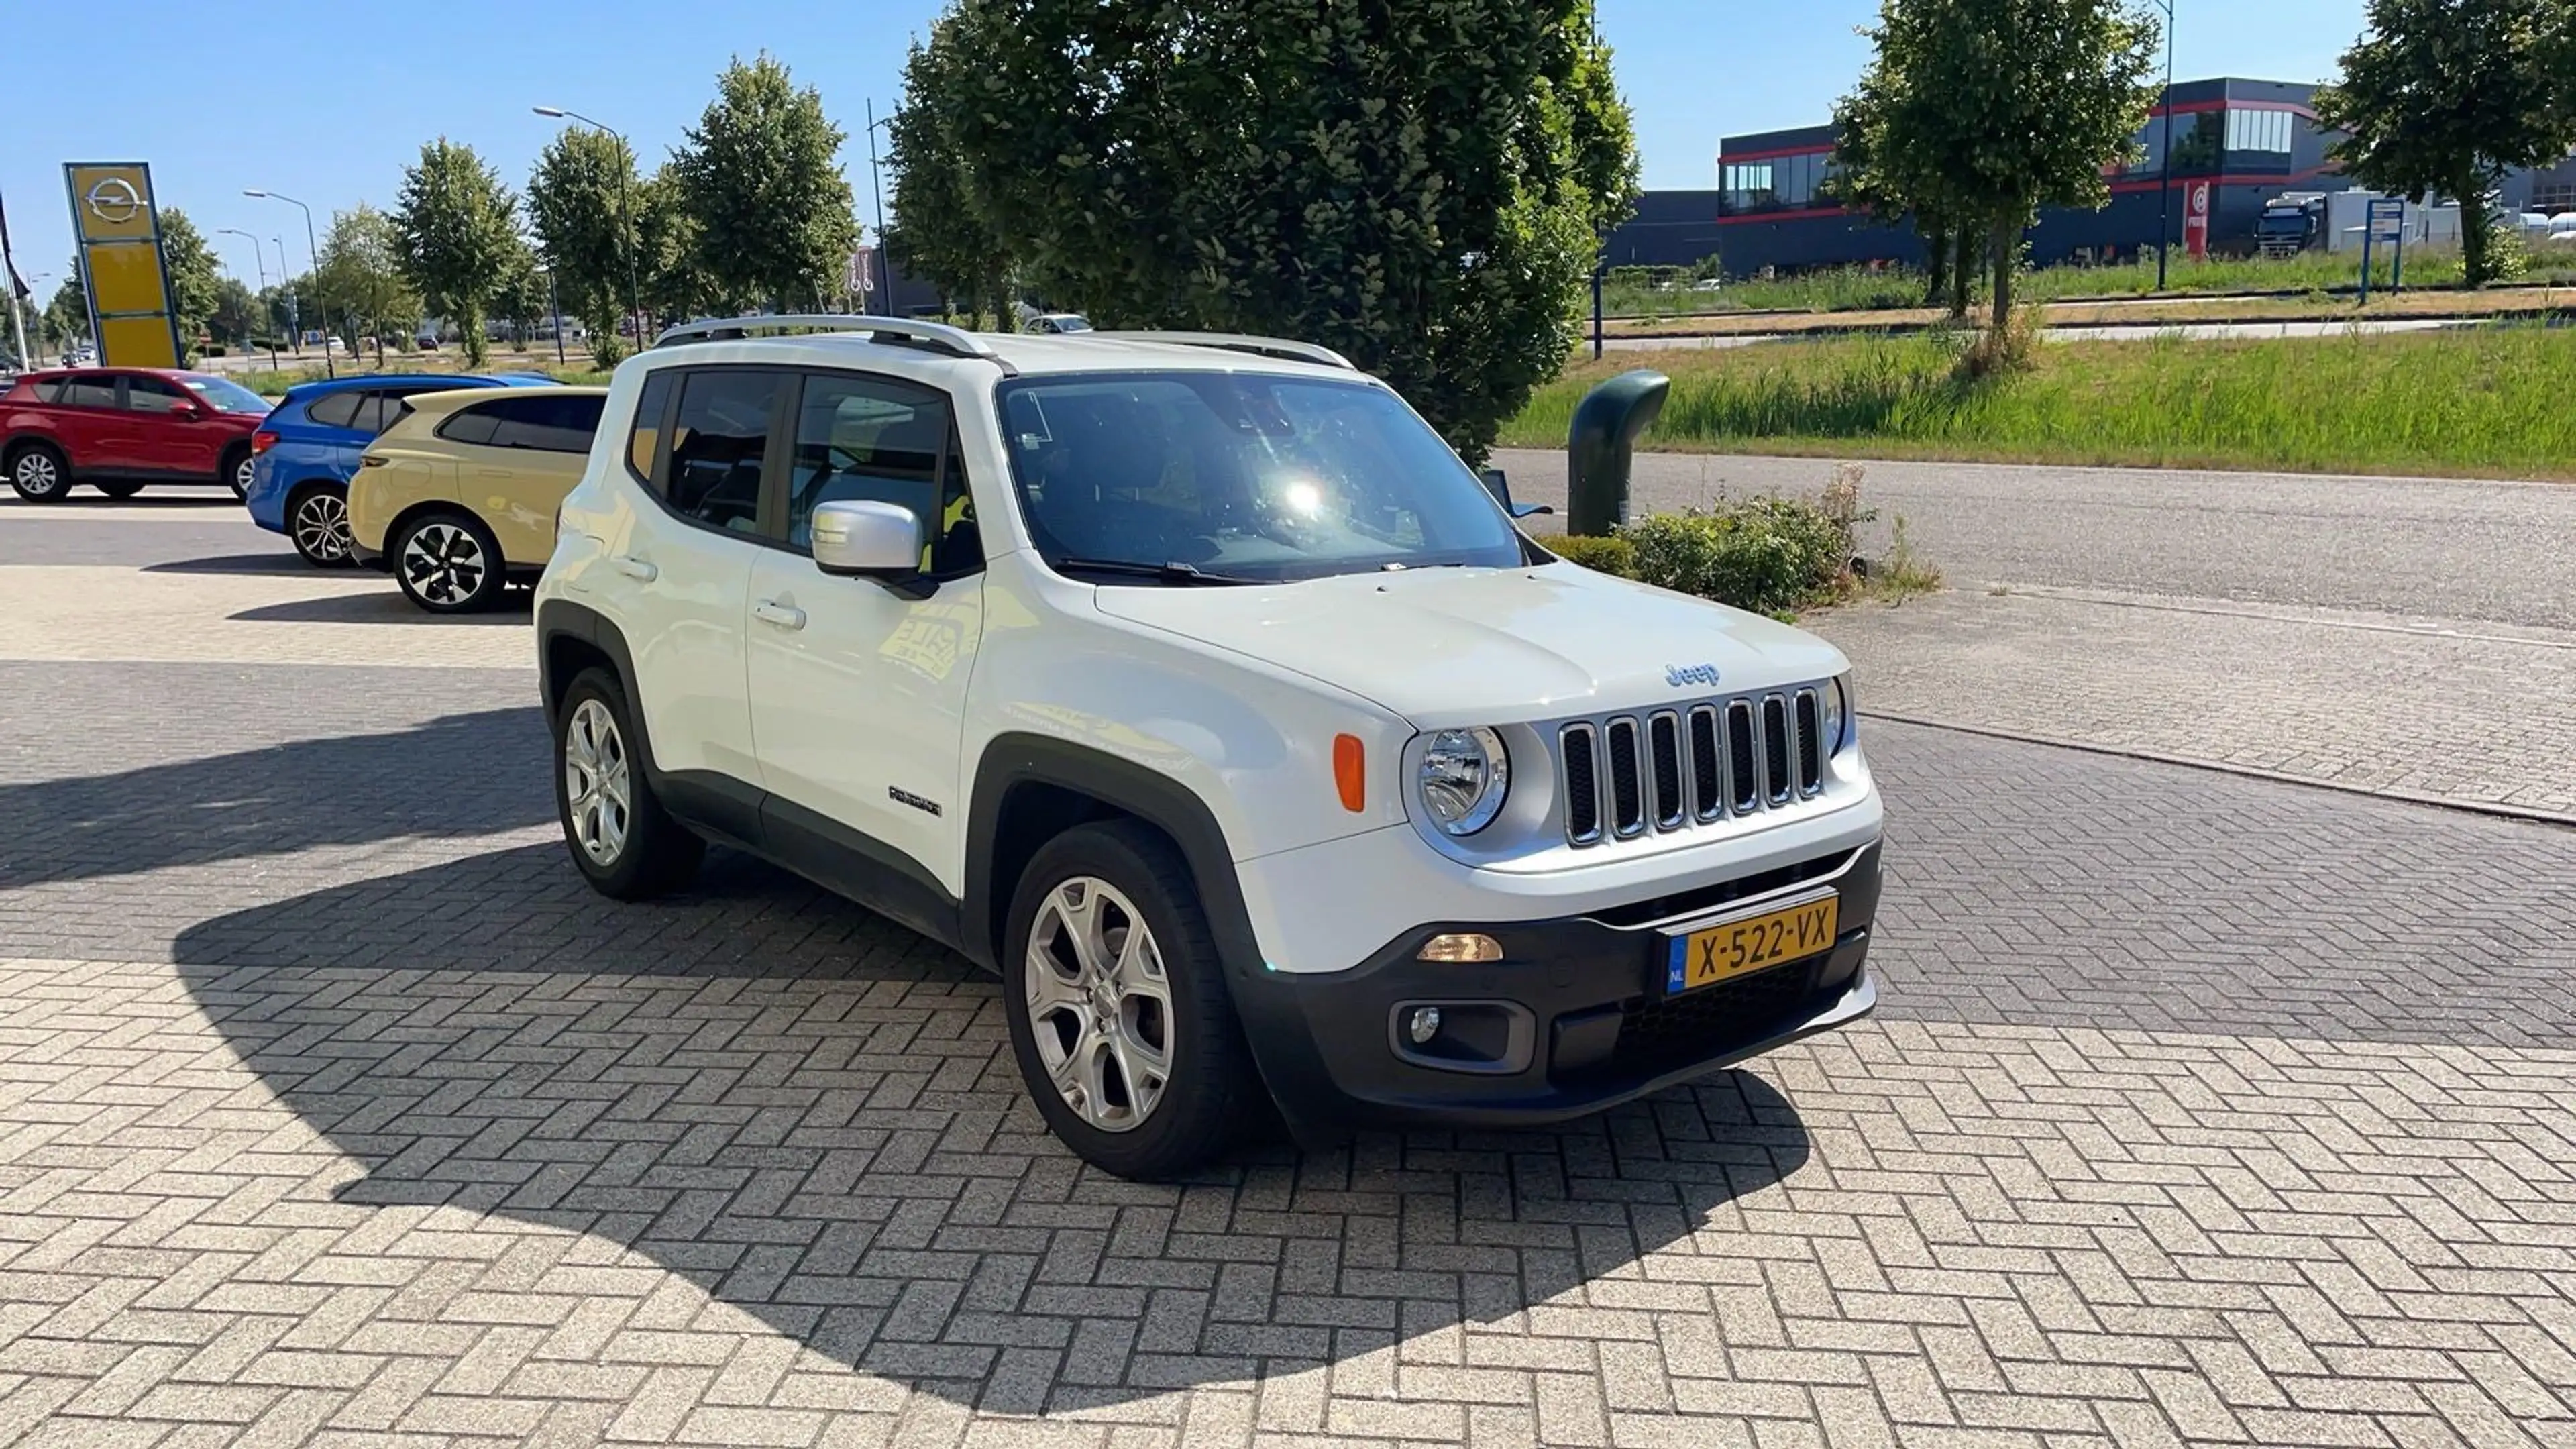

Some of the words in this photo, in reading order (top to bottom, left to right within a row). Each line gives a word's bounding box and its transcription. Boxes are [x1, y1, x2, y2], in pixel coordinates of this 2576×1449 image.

[1664, 663, 1719, 687] Jeep
[1698, 906, 1829, 977] X-522-VX
[1670, 969, 1684, 983] NL
